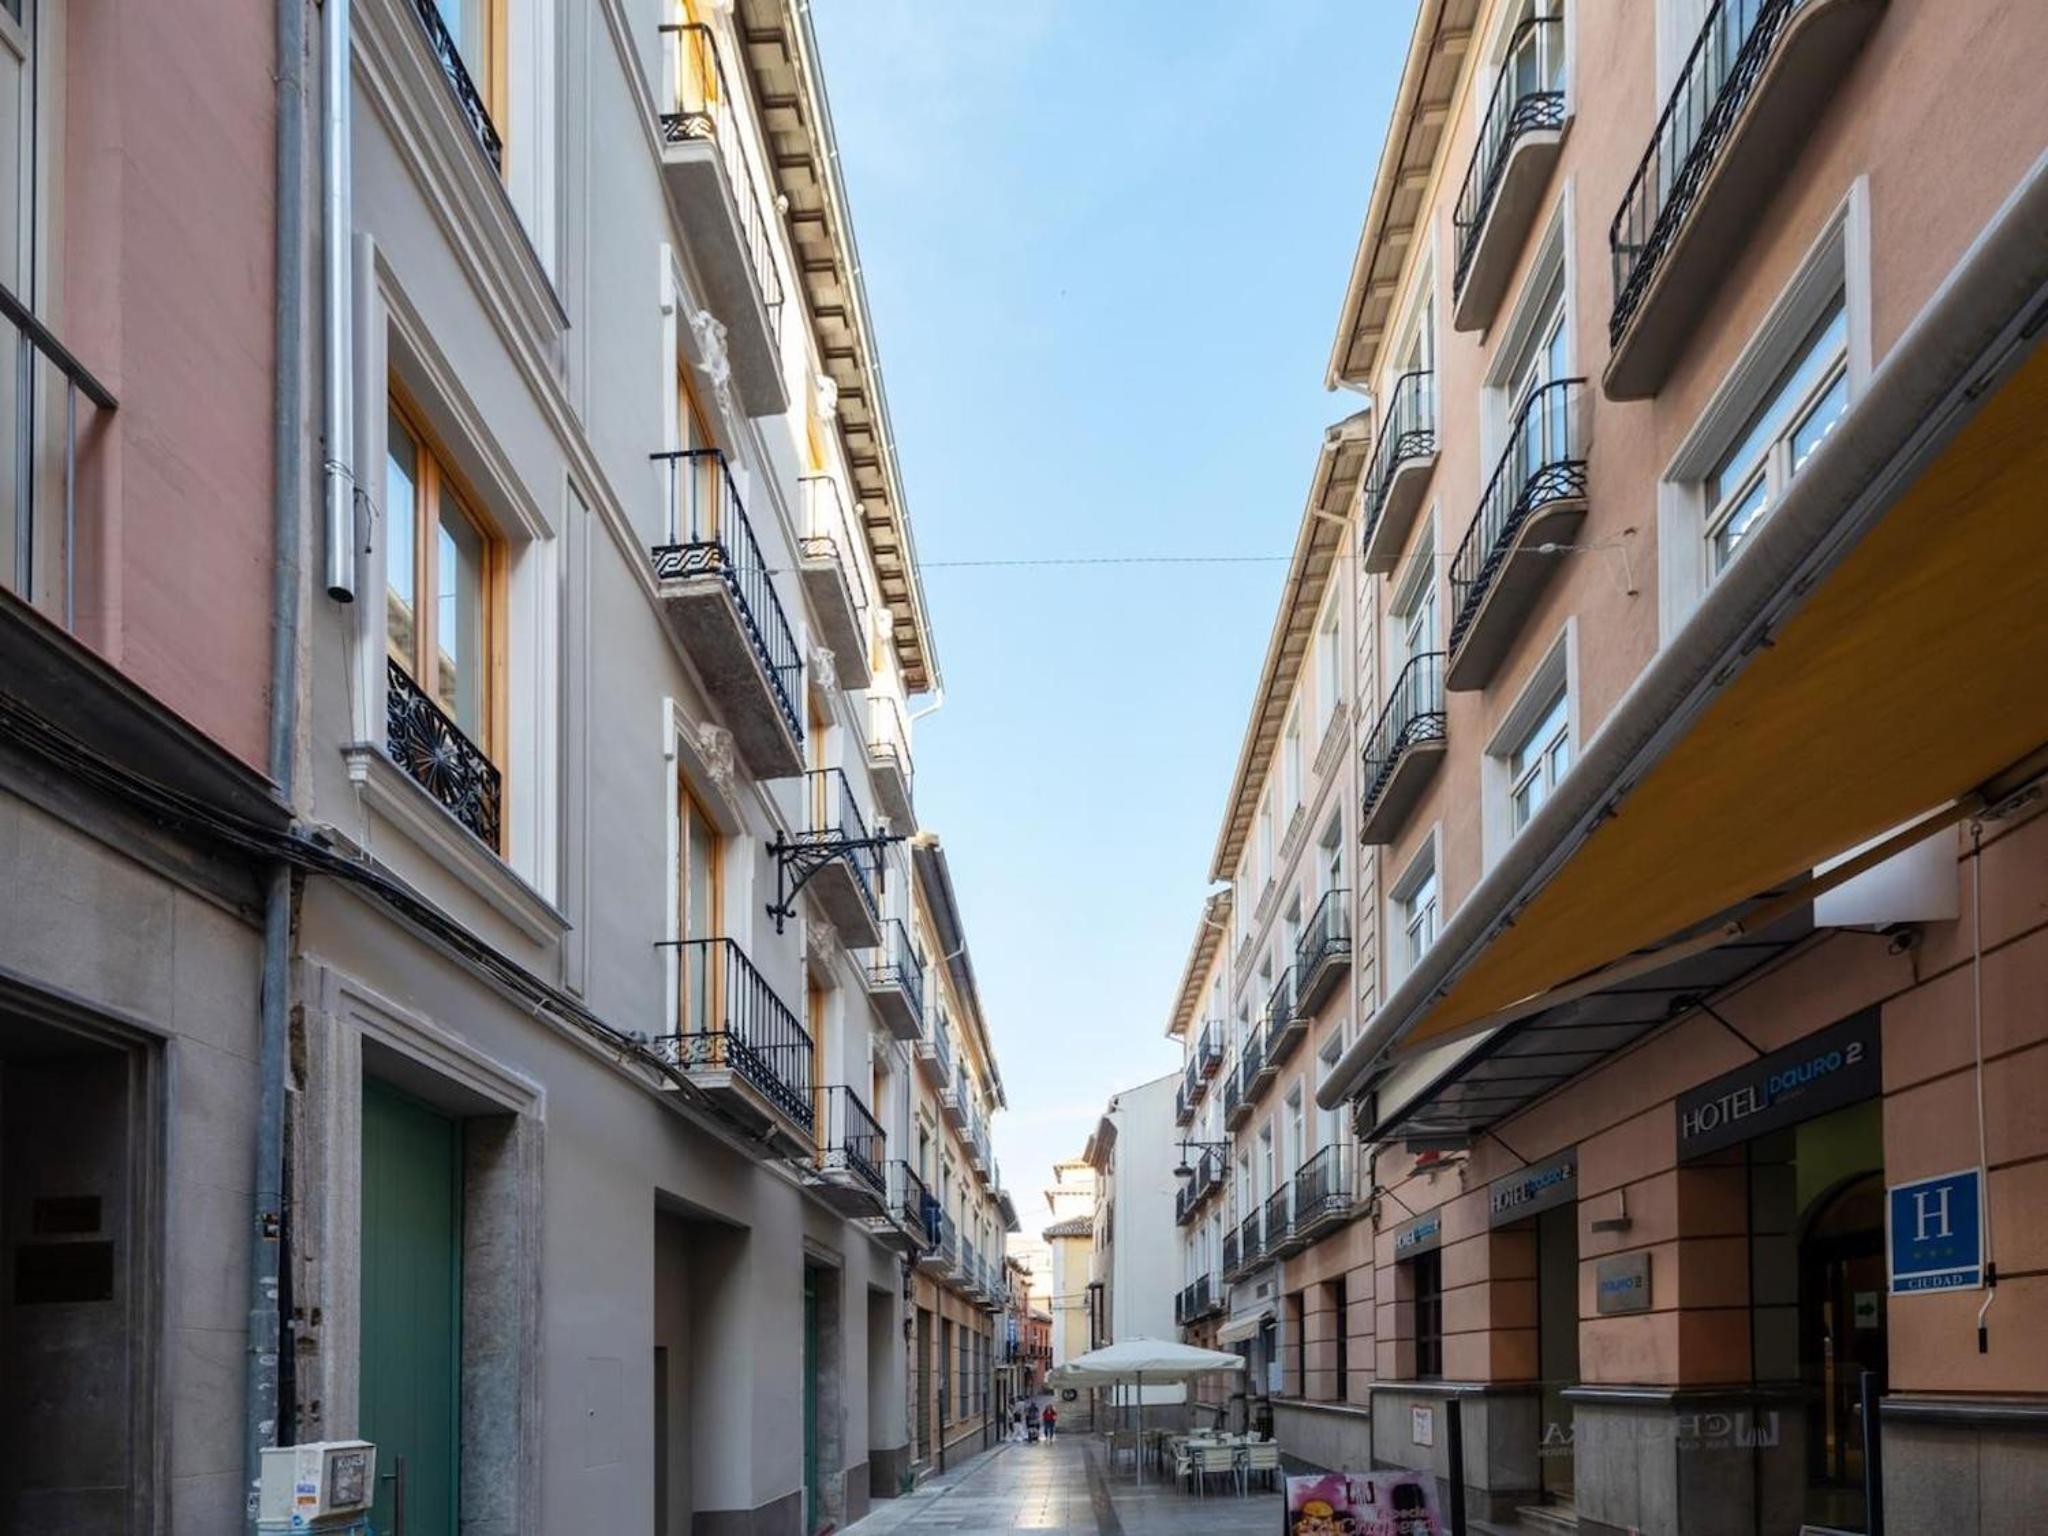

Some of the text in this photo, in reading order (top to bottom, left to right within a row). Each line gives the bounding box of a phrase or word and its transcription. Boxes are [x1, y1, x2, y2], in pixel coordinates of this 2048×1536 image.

[1682, 1083, 1765, 1139] HOTEL
[1846, 1042, 1863, 1065] 2
[1491, 1181, 1530, 1213] HOTEL
[1912, 1187, 1953, 1241] H
[1908, 1275, 1963, 1289] CIUDAD
